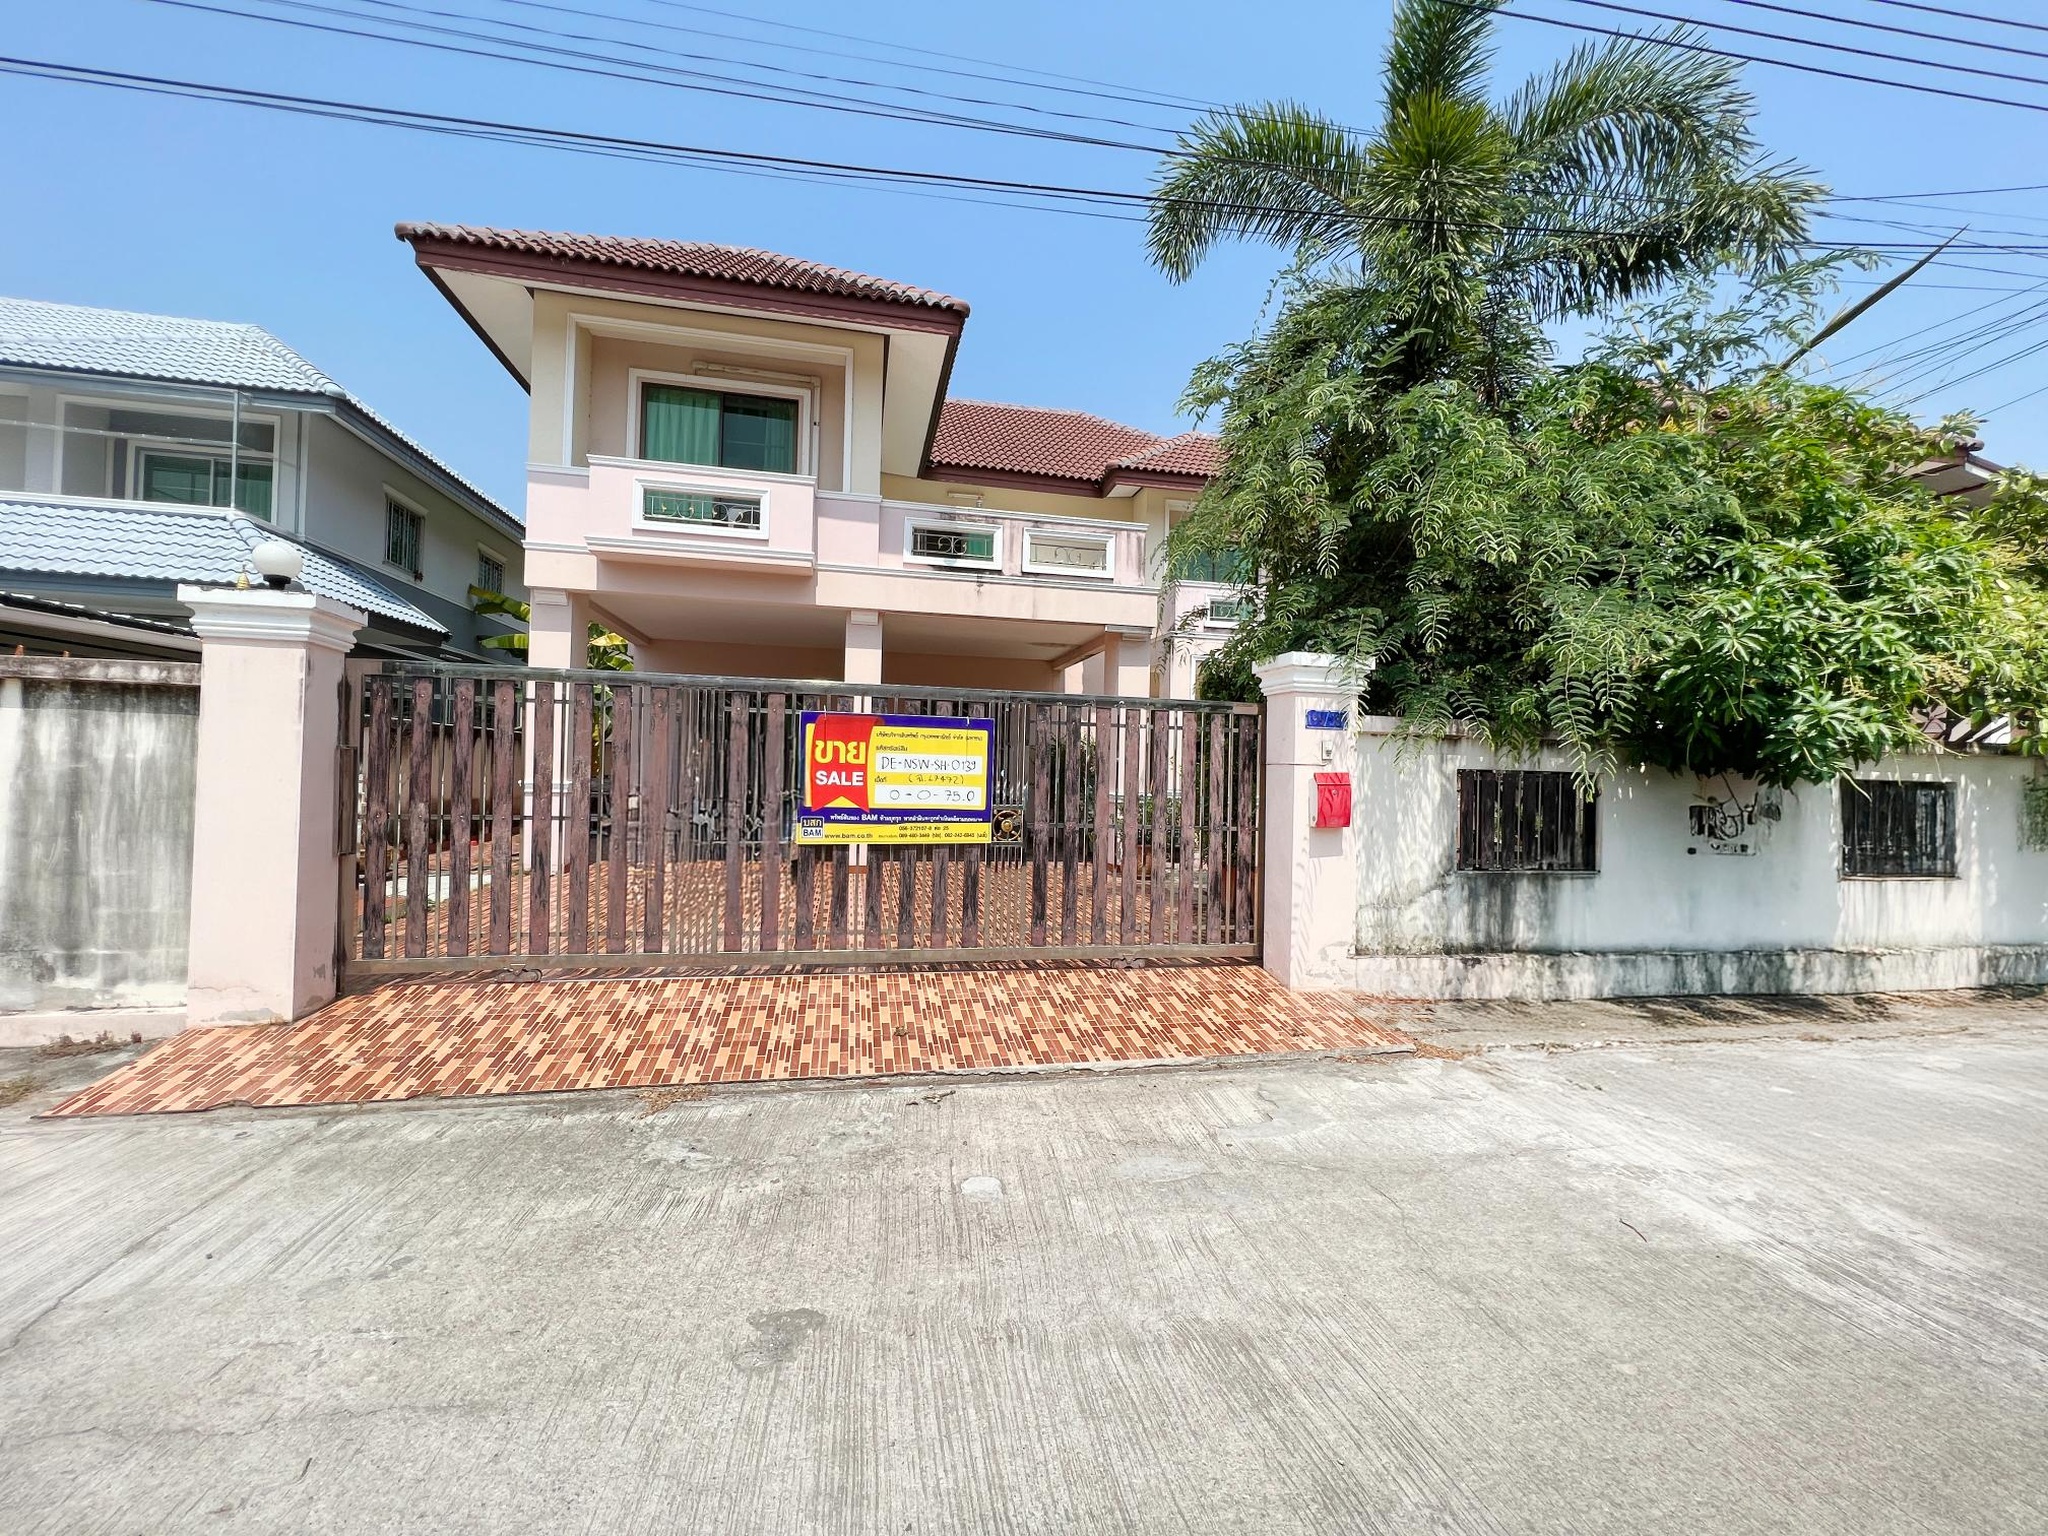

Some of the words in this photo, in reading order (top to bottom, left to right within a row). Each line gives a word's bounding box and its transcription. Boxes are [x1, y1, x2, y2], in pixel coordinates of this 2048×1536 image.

[814, 739, 866, 764] ขาย
[815, 771, 864, 786] SALE
[802, 829, 822, 837] BAM
